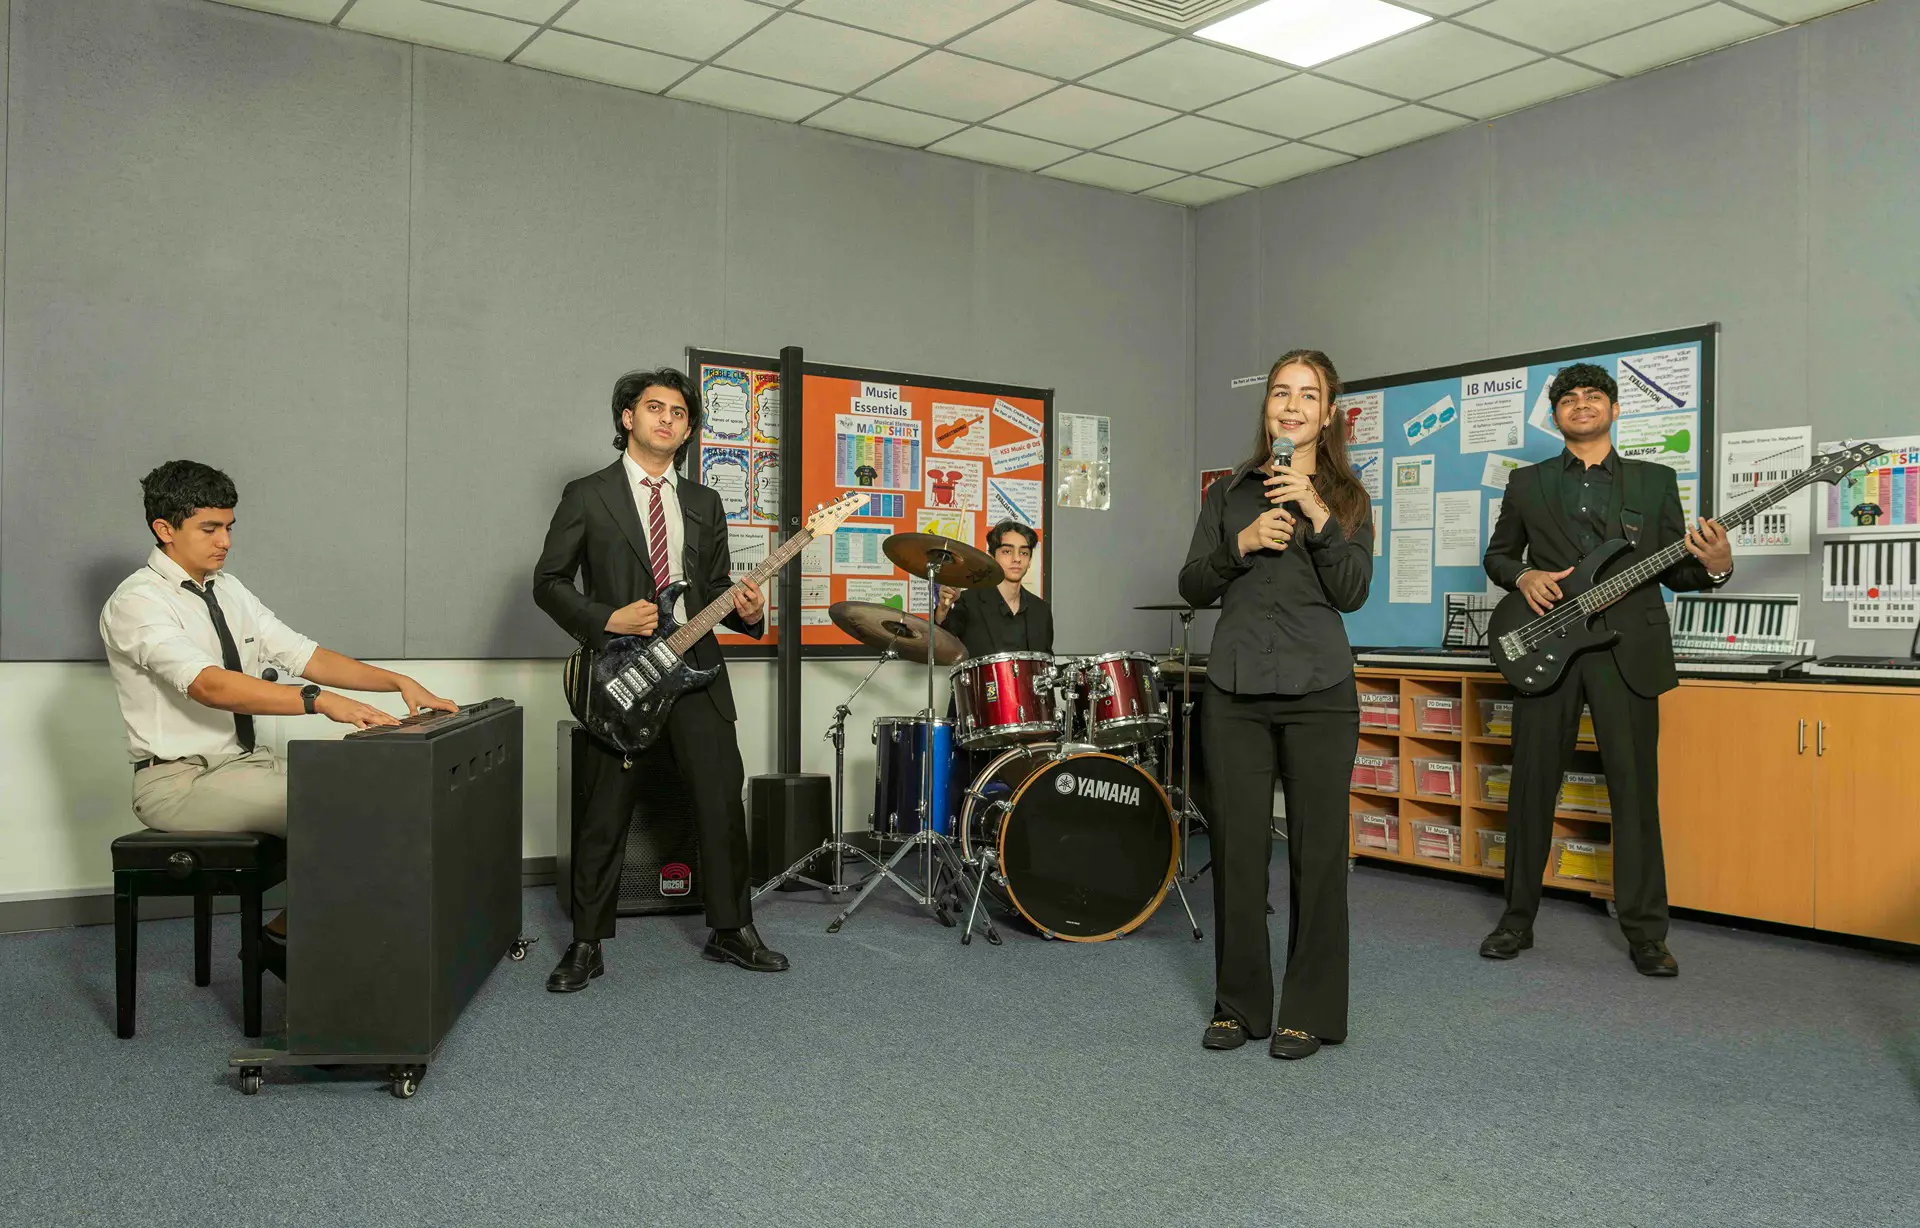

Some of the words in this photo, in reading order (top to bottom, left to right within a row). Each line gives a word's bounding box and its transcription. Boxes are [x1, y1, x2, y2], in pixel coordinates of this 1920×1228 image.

[706, 368, 730, 378] TREBLE
[866, 386, 897, 399] Music
[1467, 383, 1479, 396] IB
[1484, 377, 1522, 394] Music
[1628, 375, 1662, 403] EVALUATION
[855, 401, 908, 416] Essentials
[857, 423, 918, 437] MADTSHIRT
[1018, 419, 1028, 428] Music
[1624, 447, 1656, 456] ANALYSIS
[1868, 453, 1920, 466] ADTSH
[995, 494, 1019, 521] EVALUATING
[1077, 776, 1140, 806] YAMAHA
